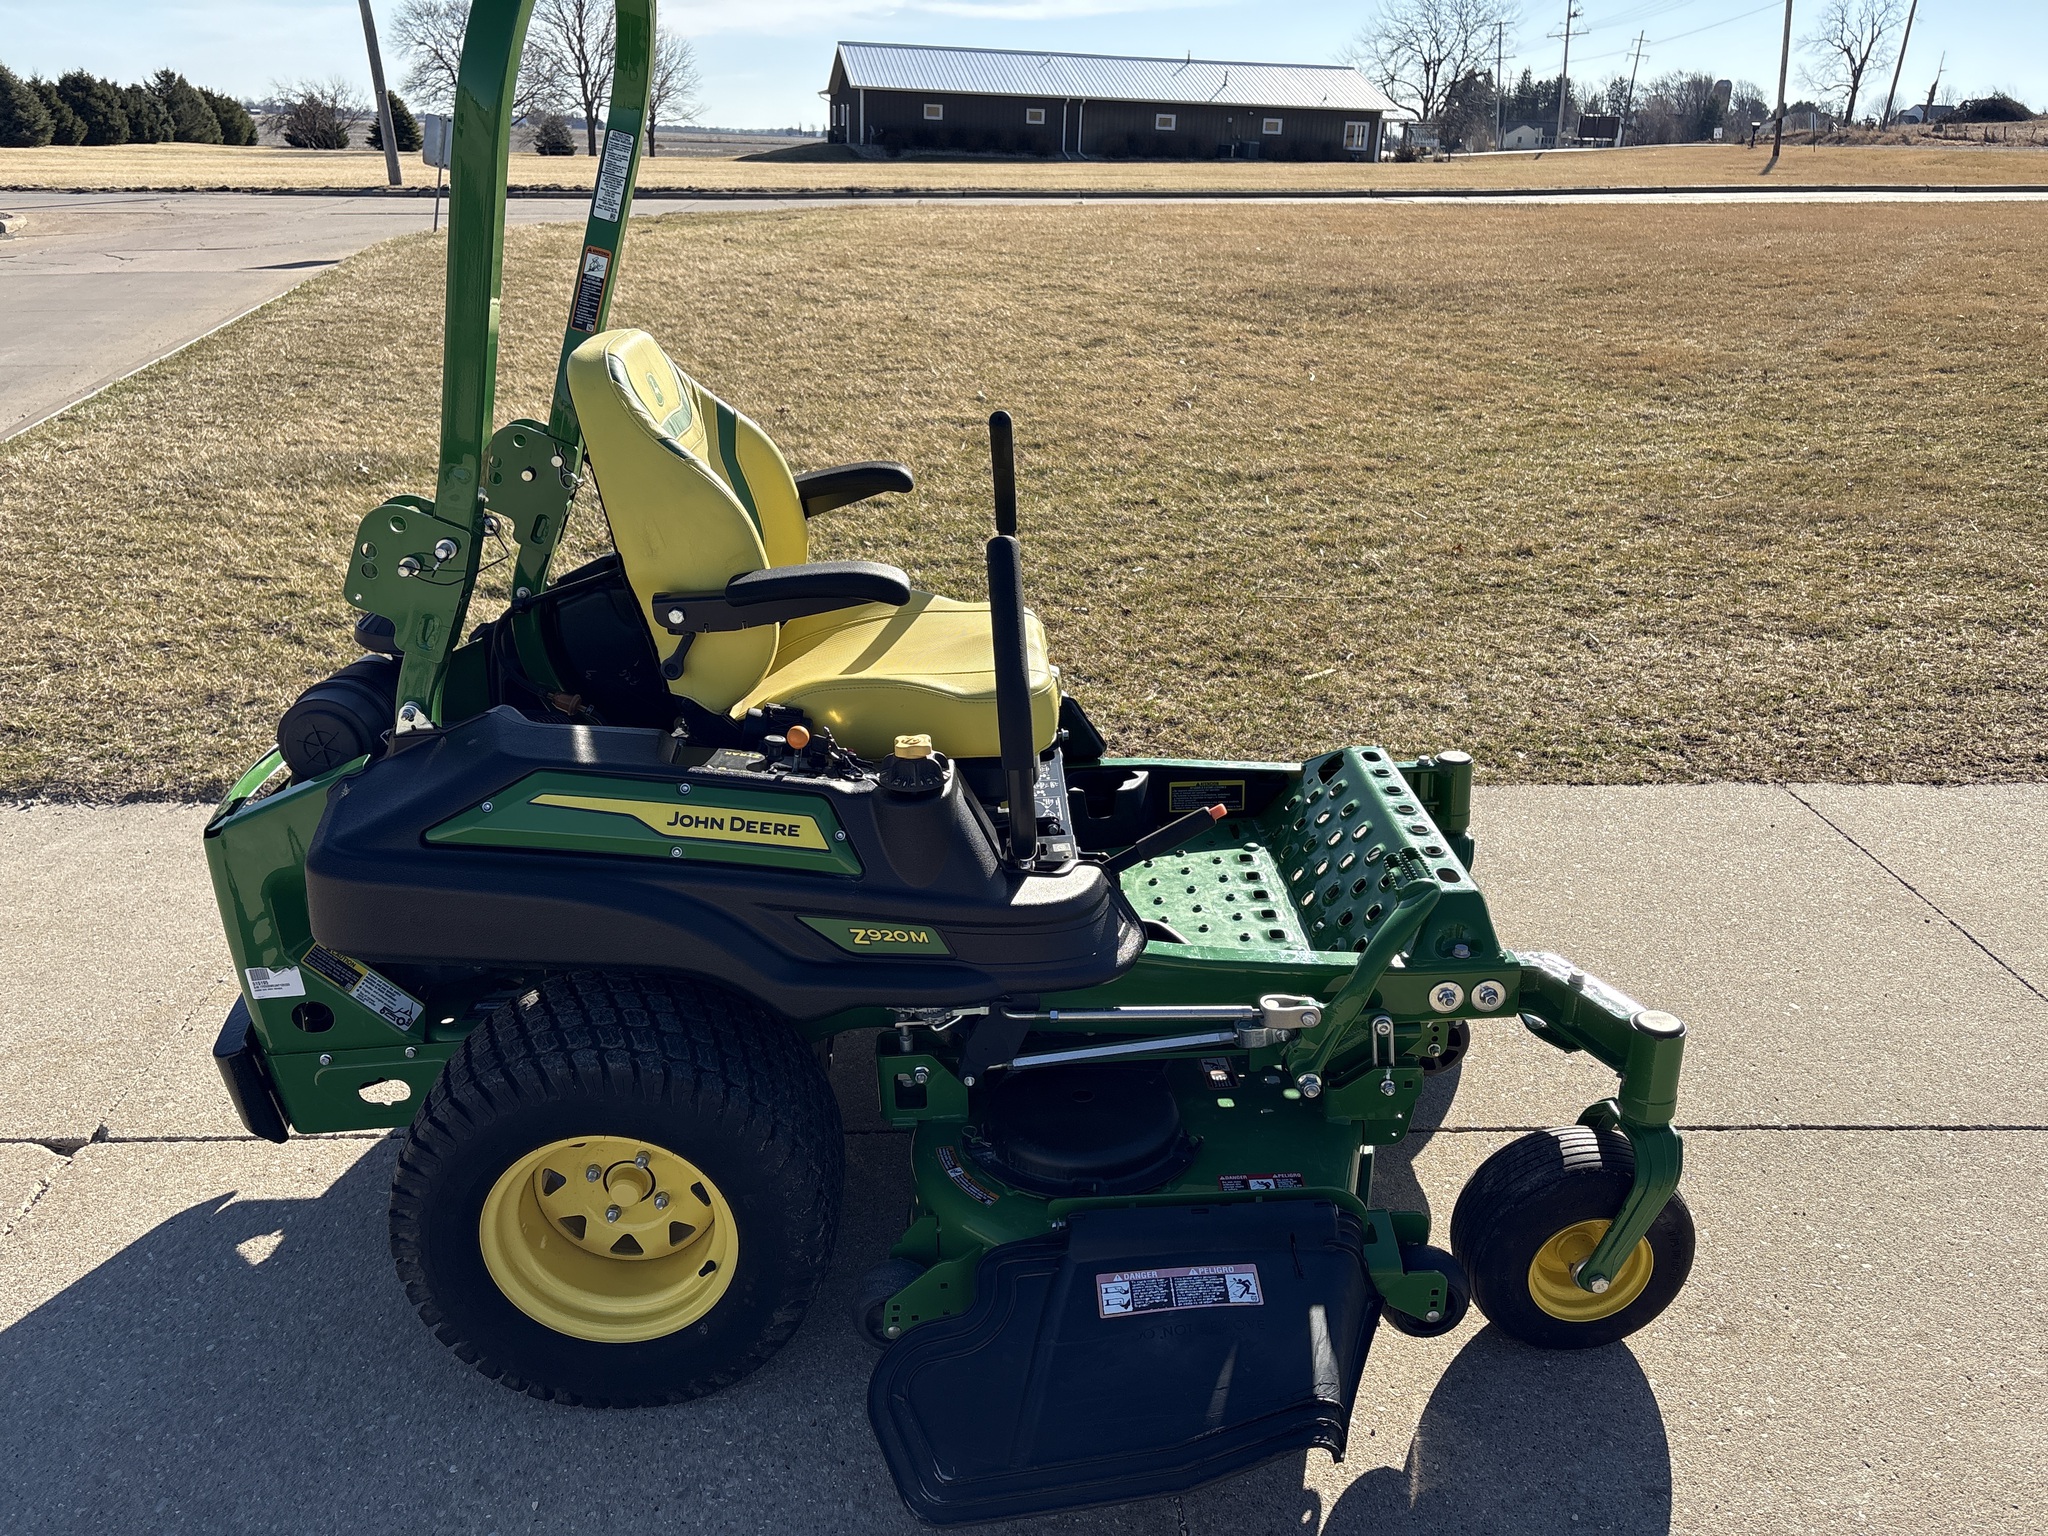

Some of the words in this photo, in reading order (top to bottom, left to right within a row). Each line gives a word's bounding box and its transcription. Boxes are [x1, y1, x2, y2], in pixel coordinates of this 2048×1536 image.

[666, 811, 725, 831] JOHN
[729, 816, 801, 838] DEERE
[848, 928, 931, 946] Z920M
[1123, 1270, 1159, 1281] DANGER
[1198, 1266, 1235, 1275] PELIGRO
